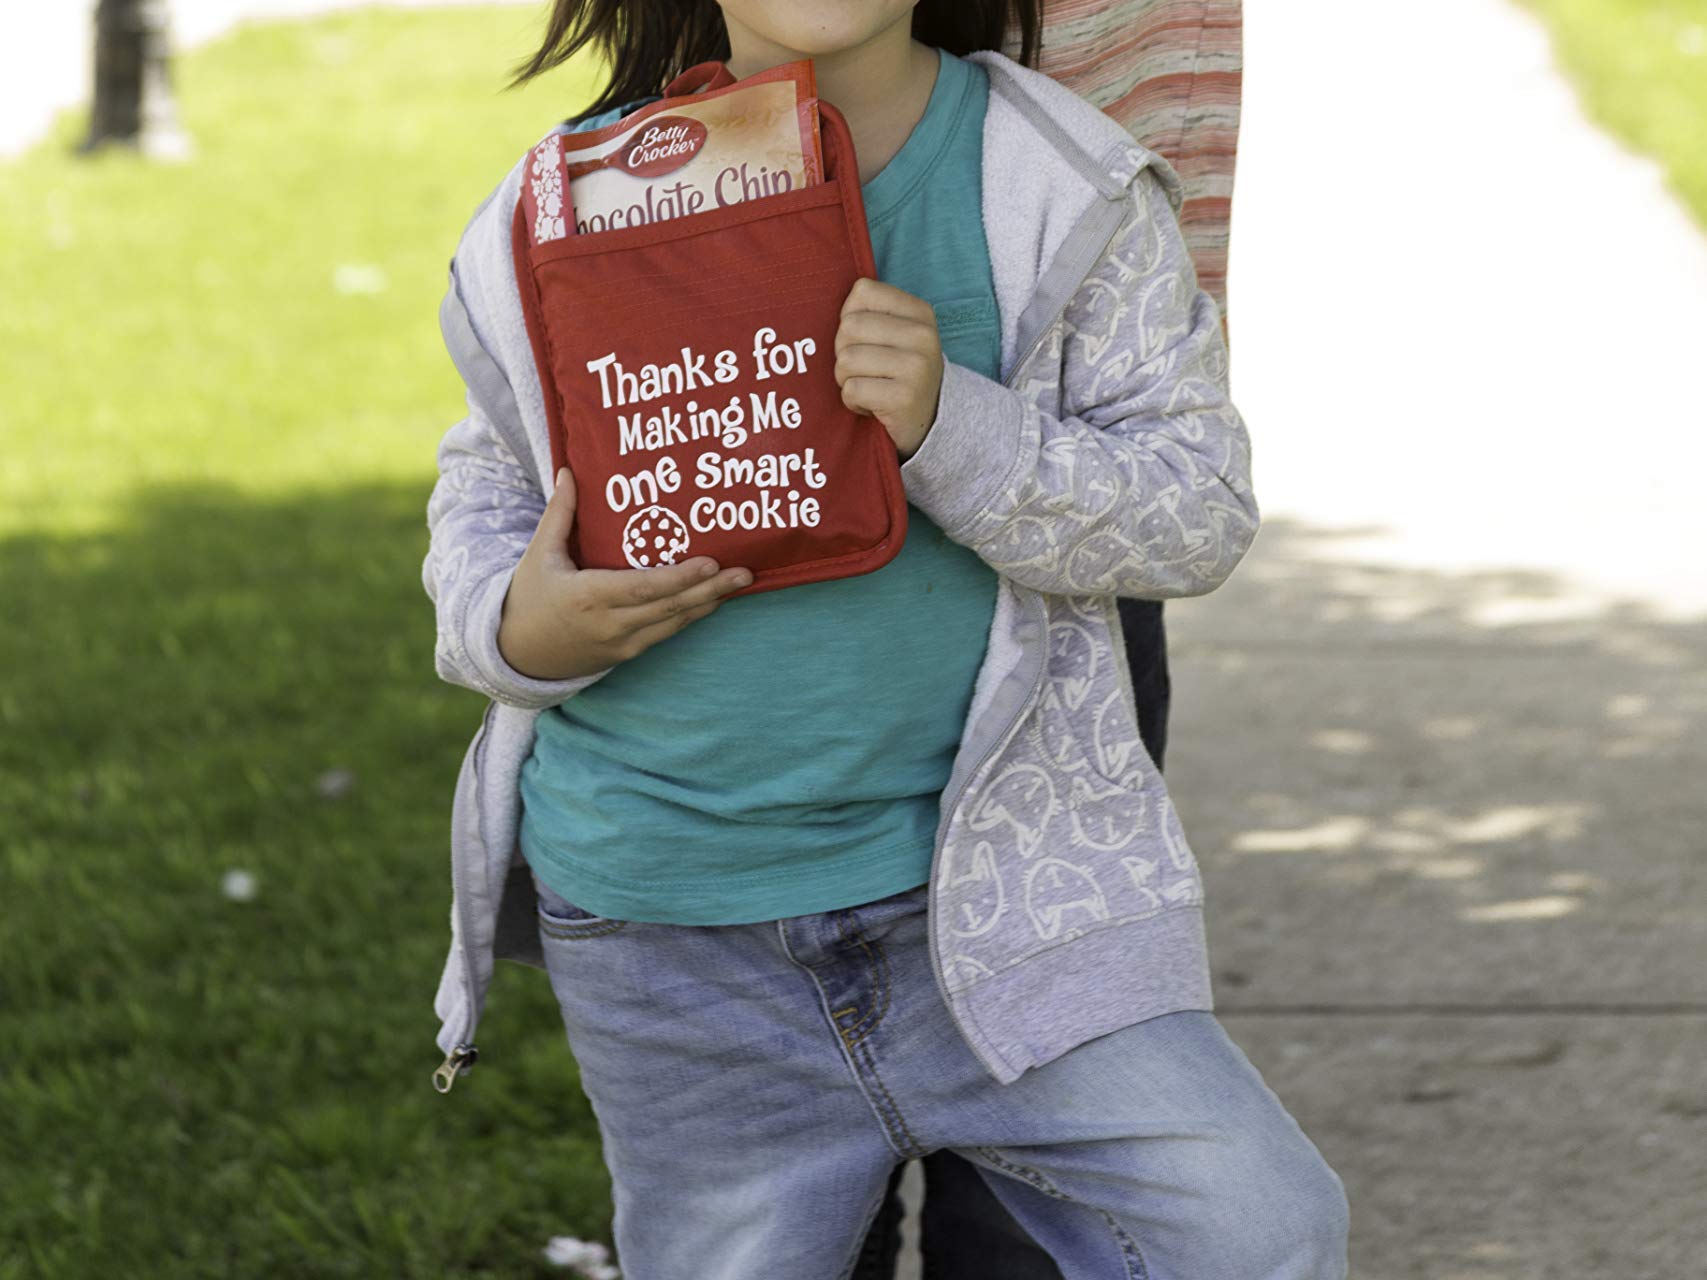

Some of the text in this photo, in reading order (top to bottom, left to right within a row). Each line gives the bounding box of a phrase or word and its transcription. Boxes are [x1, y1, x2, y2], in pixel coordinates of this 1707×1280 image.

[627, 138, 695, 169] Crocker
[641, 125, 689, 148] Betty
[586, 327, 817, 409] Thanks for
[617, 391, 802, 456] Making Me
[605, 448, 827, 513] One Smart
[689, 490, 821, 533] Cookie
